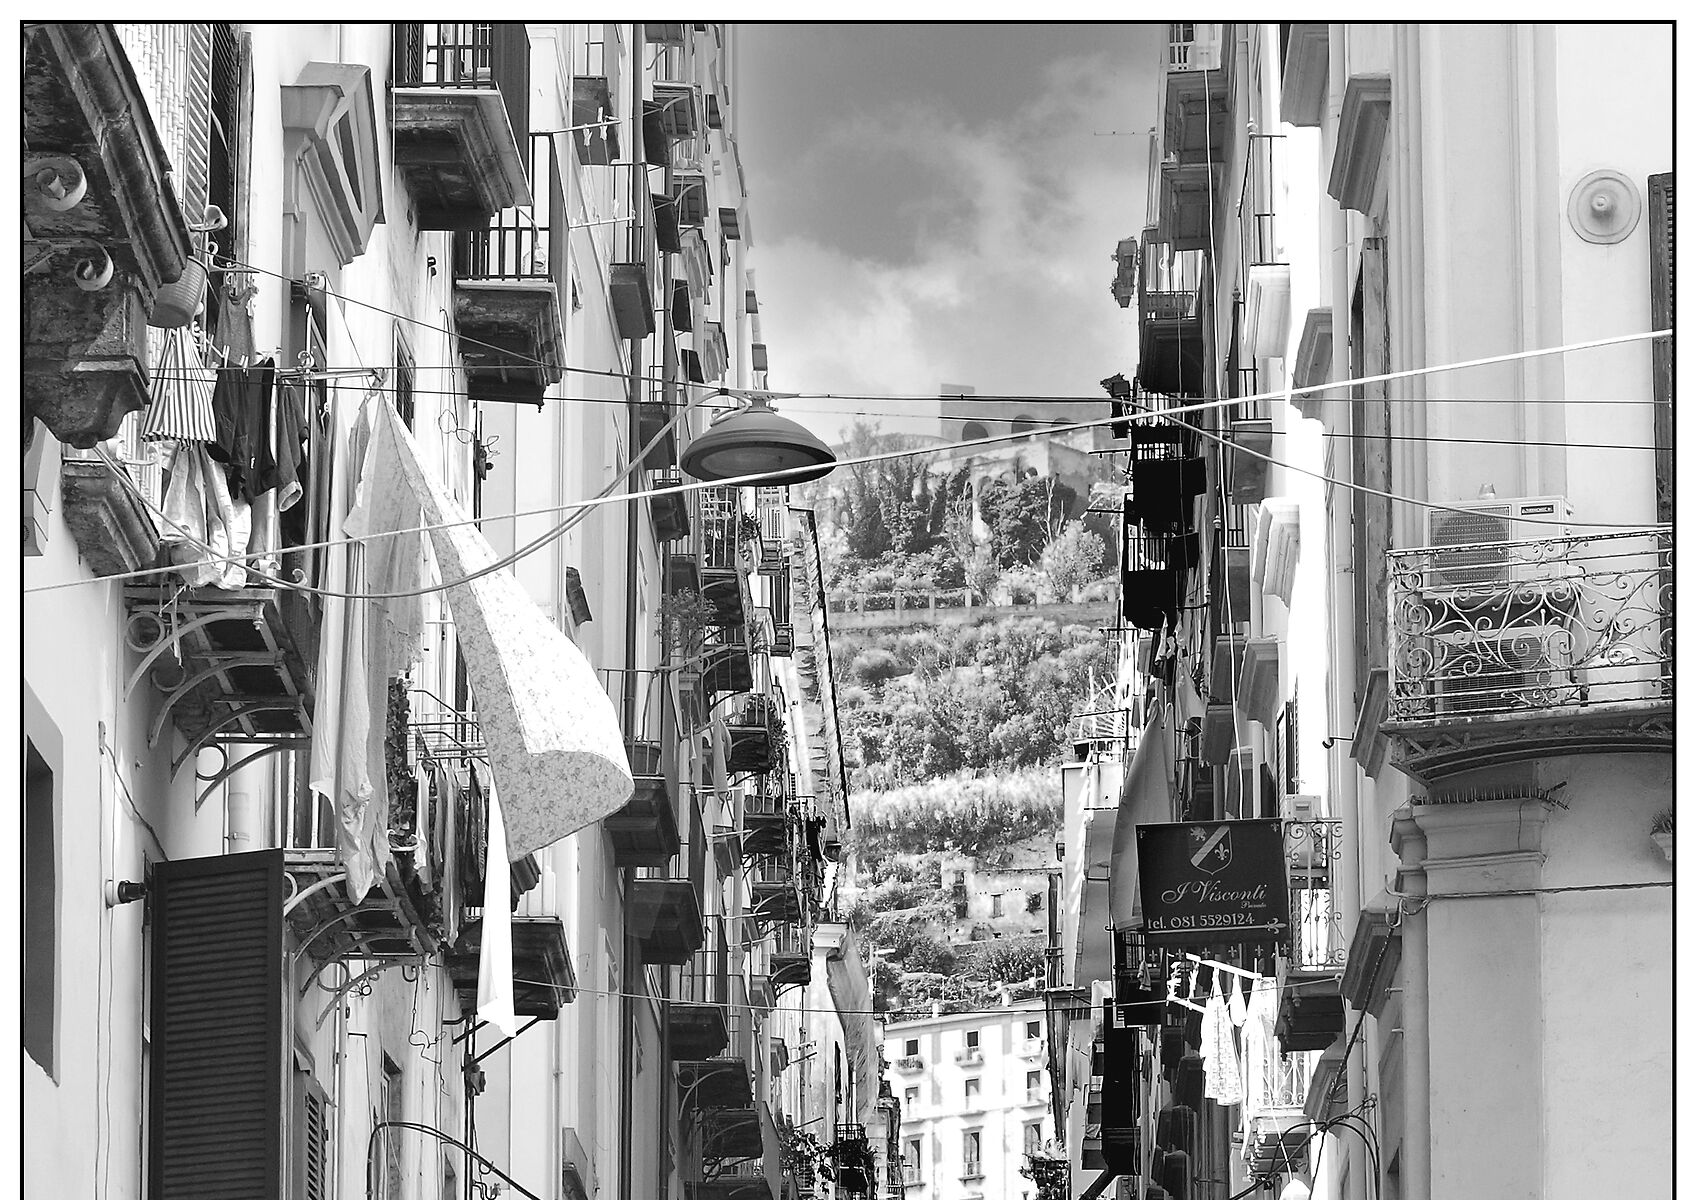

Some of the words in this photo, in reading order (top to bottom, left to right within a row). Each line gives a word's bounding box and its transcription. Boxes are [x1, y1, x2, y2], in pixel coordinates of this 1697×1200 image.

[1191, 880, 1268, 903] Visconti
[1147, 916, 1167, 929] tel.
[1170, 914, 1195, 929] 081
[1199, 912, 1255, 927] 5529124
